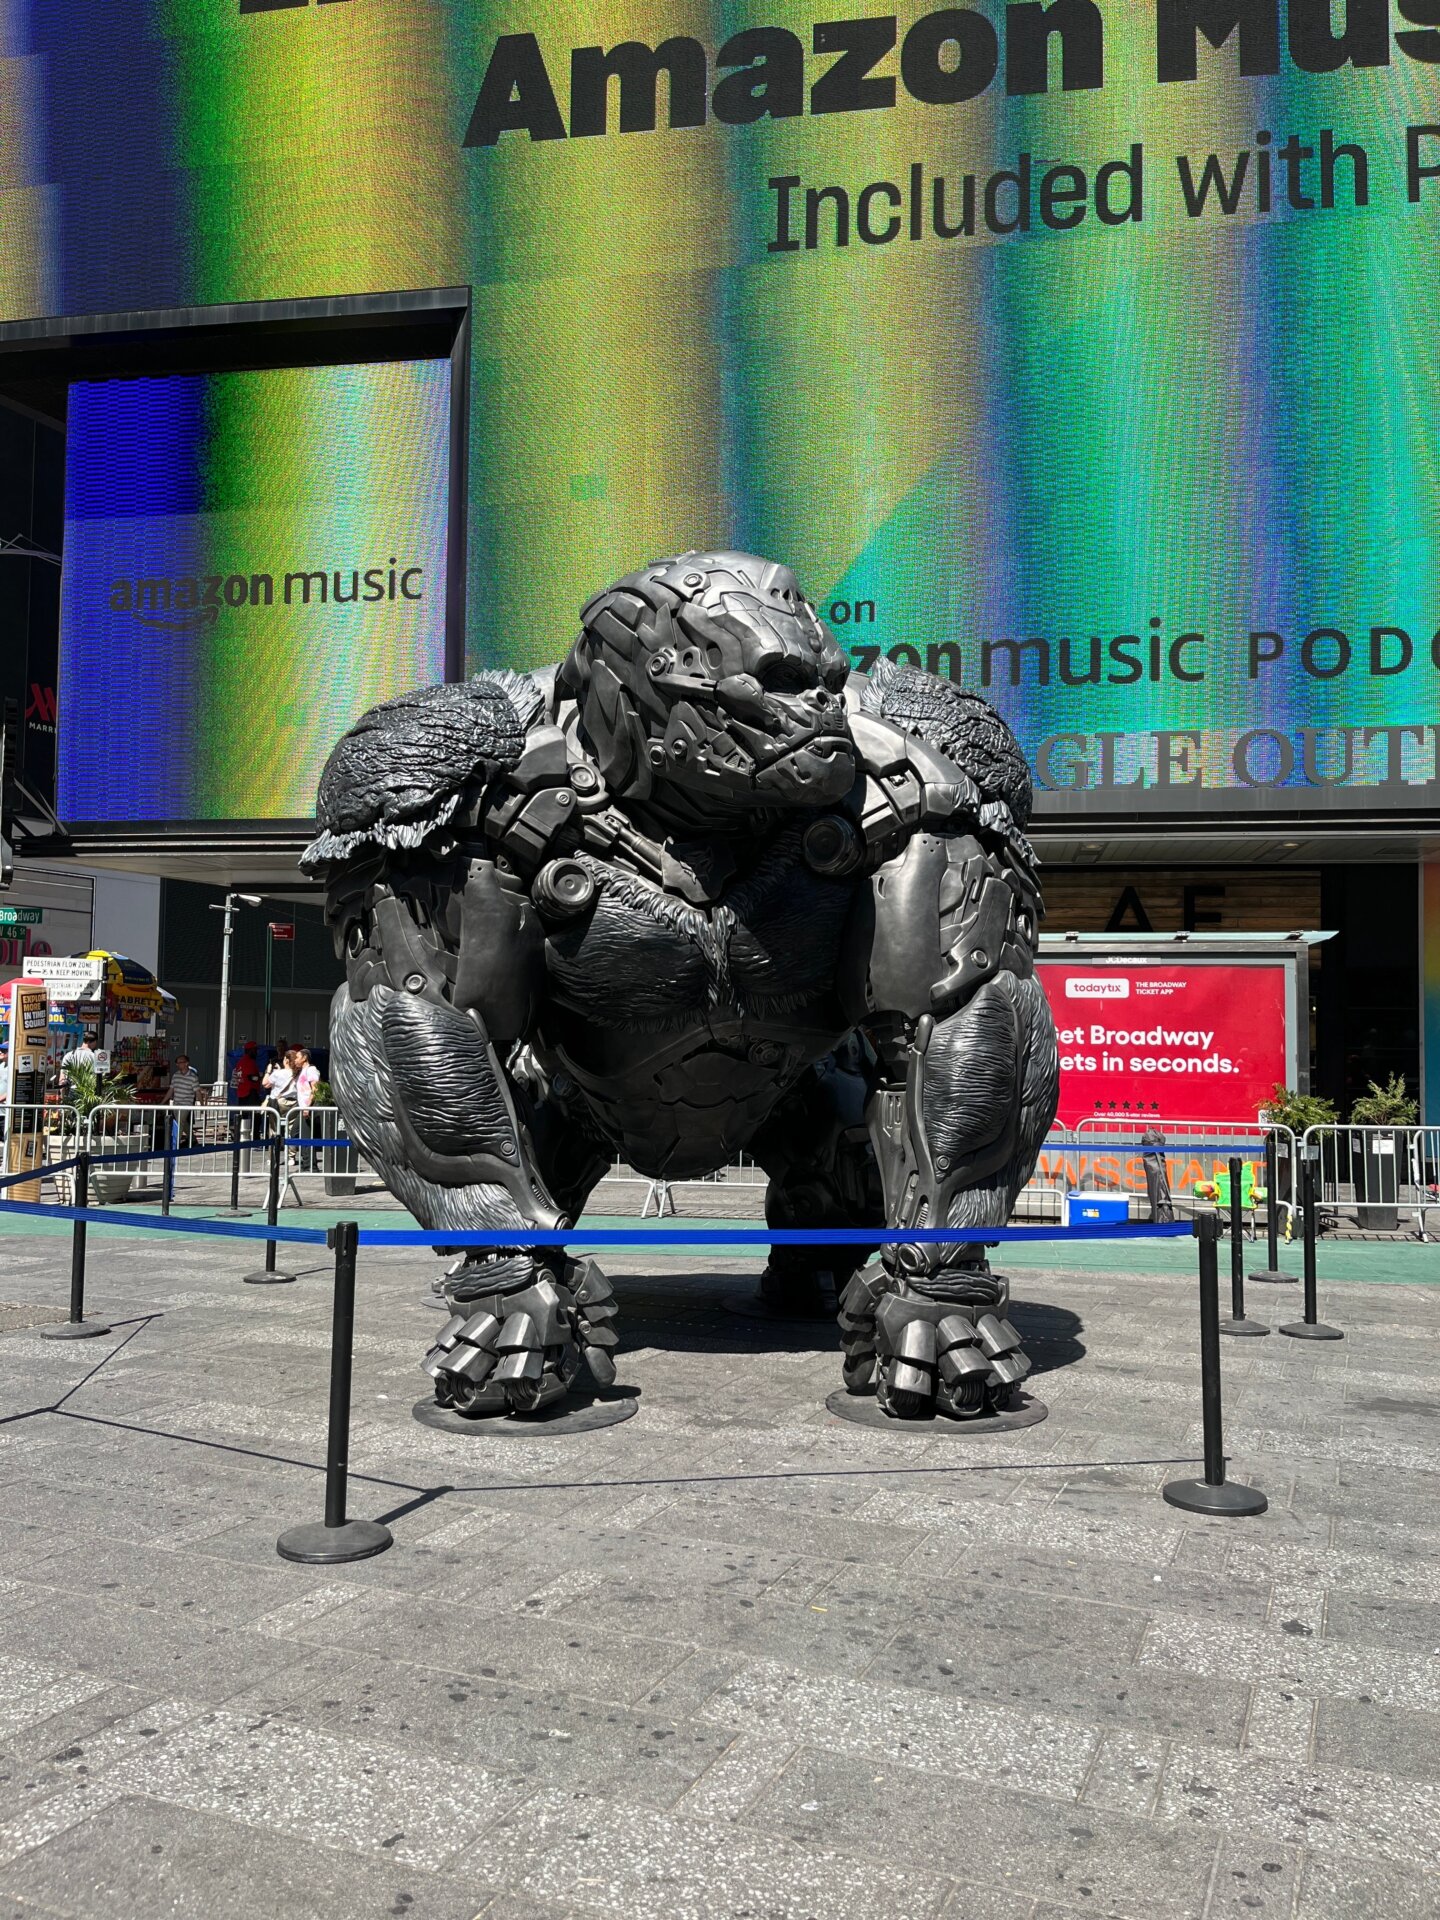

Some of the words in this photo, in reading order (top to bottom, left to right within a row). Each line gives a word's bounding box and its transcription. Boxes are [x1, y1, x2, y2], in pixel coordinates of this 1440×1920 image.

[462, 0, 1104, 148] Amazon
[768, 143, 1143, 253] Included
[1176, 130, 1369, 218] with
[109, 573, 273, 613] amazon
[283, 557, 423, 603] music
[830, 600, 875, 624] on
[981, 617, 1204, 687] music
[1249, 627, 1440, 681] POD
[1035, 730, 1202, 791] GLE
[1233, 724, 1440, 788] OUT
[7, 926, 17, 938] 46
[26, 960, 60, 968] PEDESTRIAN
[1074, 983, 1121, 994] todaytix
[1149, 981, 1187, 989] BROADWAY
[1055, 1025, 1085, 1044] et
[1090, 1025, 1214, 1050] Broadway
[1102, 1051, 1124, 1071] in
[1129, 1053, 1240, 1074] seconds.
